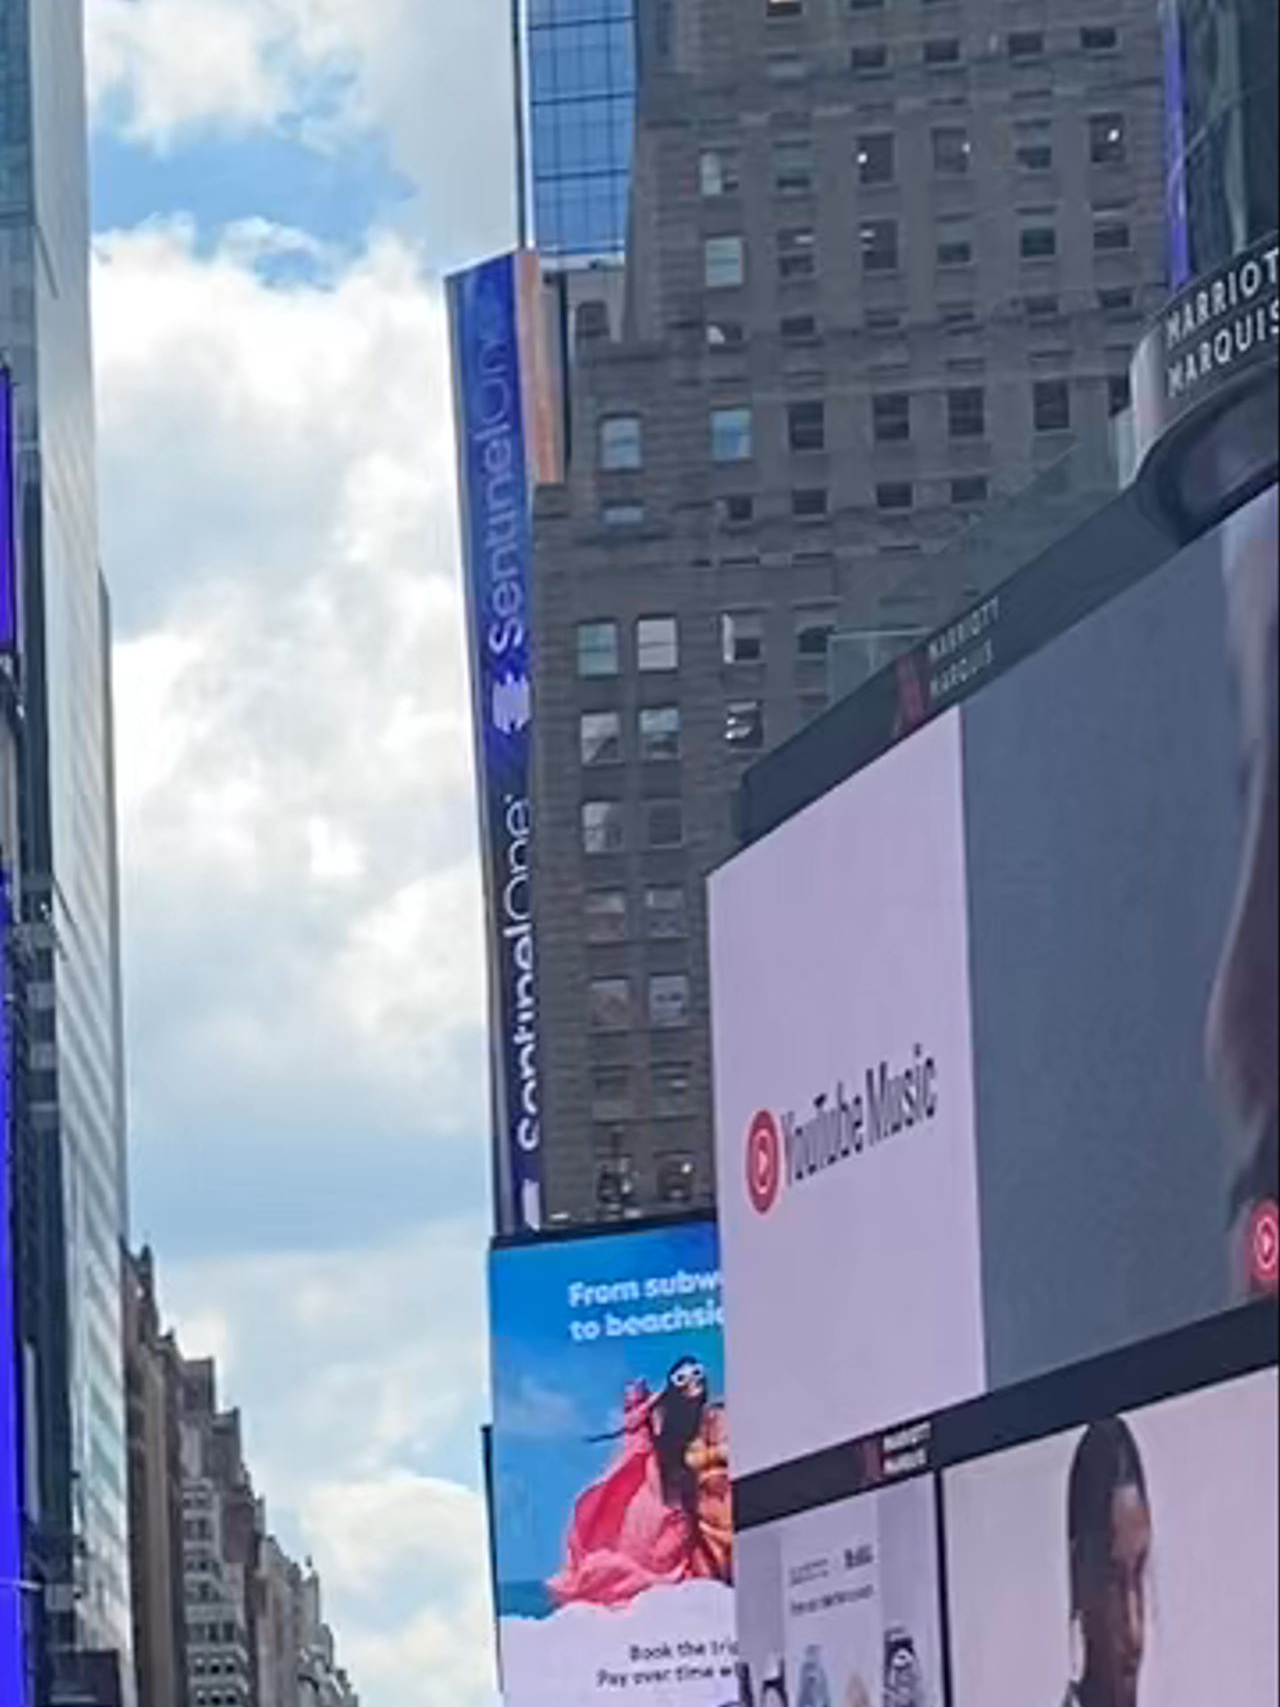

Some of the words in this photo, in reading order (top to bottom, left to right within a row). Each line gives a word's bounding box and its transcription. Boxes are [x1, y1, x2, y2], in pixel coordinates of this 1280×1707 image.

[1165, 245, 1280, 351] MARRIOT
[780, 1080, 864, 1187] YouTube
[865, 1042, 938, 1146] Music
[567, 1280, 640, 1309] From
[644, 1269, 724, 1299] subw
[568, 1320, 601, 1341] to
[629, 1643, 673, 1661] Book
[677, 1639, 706, 1656] the
[596, 1667, 628, 1687] Pay
[633, 1667, 671, 1685] over
[676, 1663, 714, 1681] time
